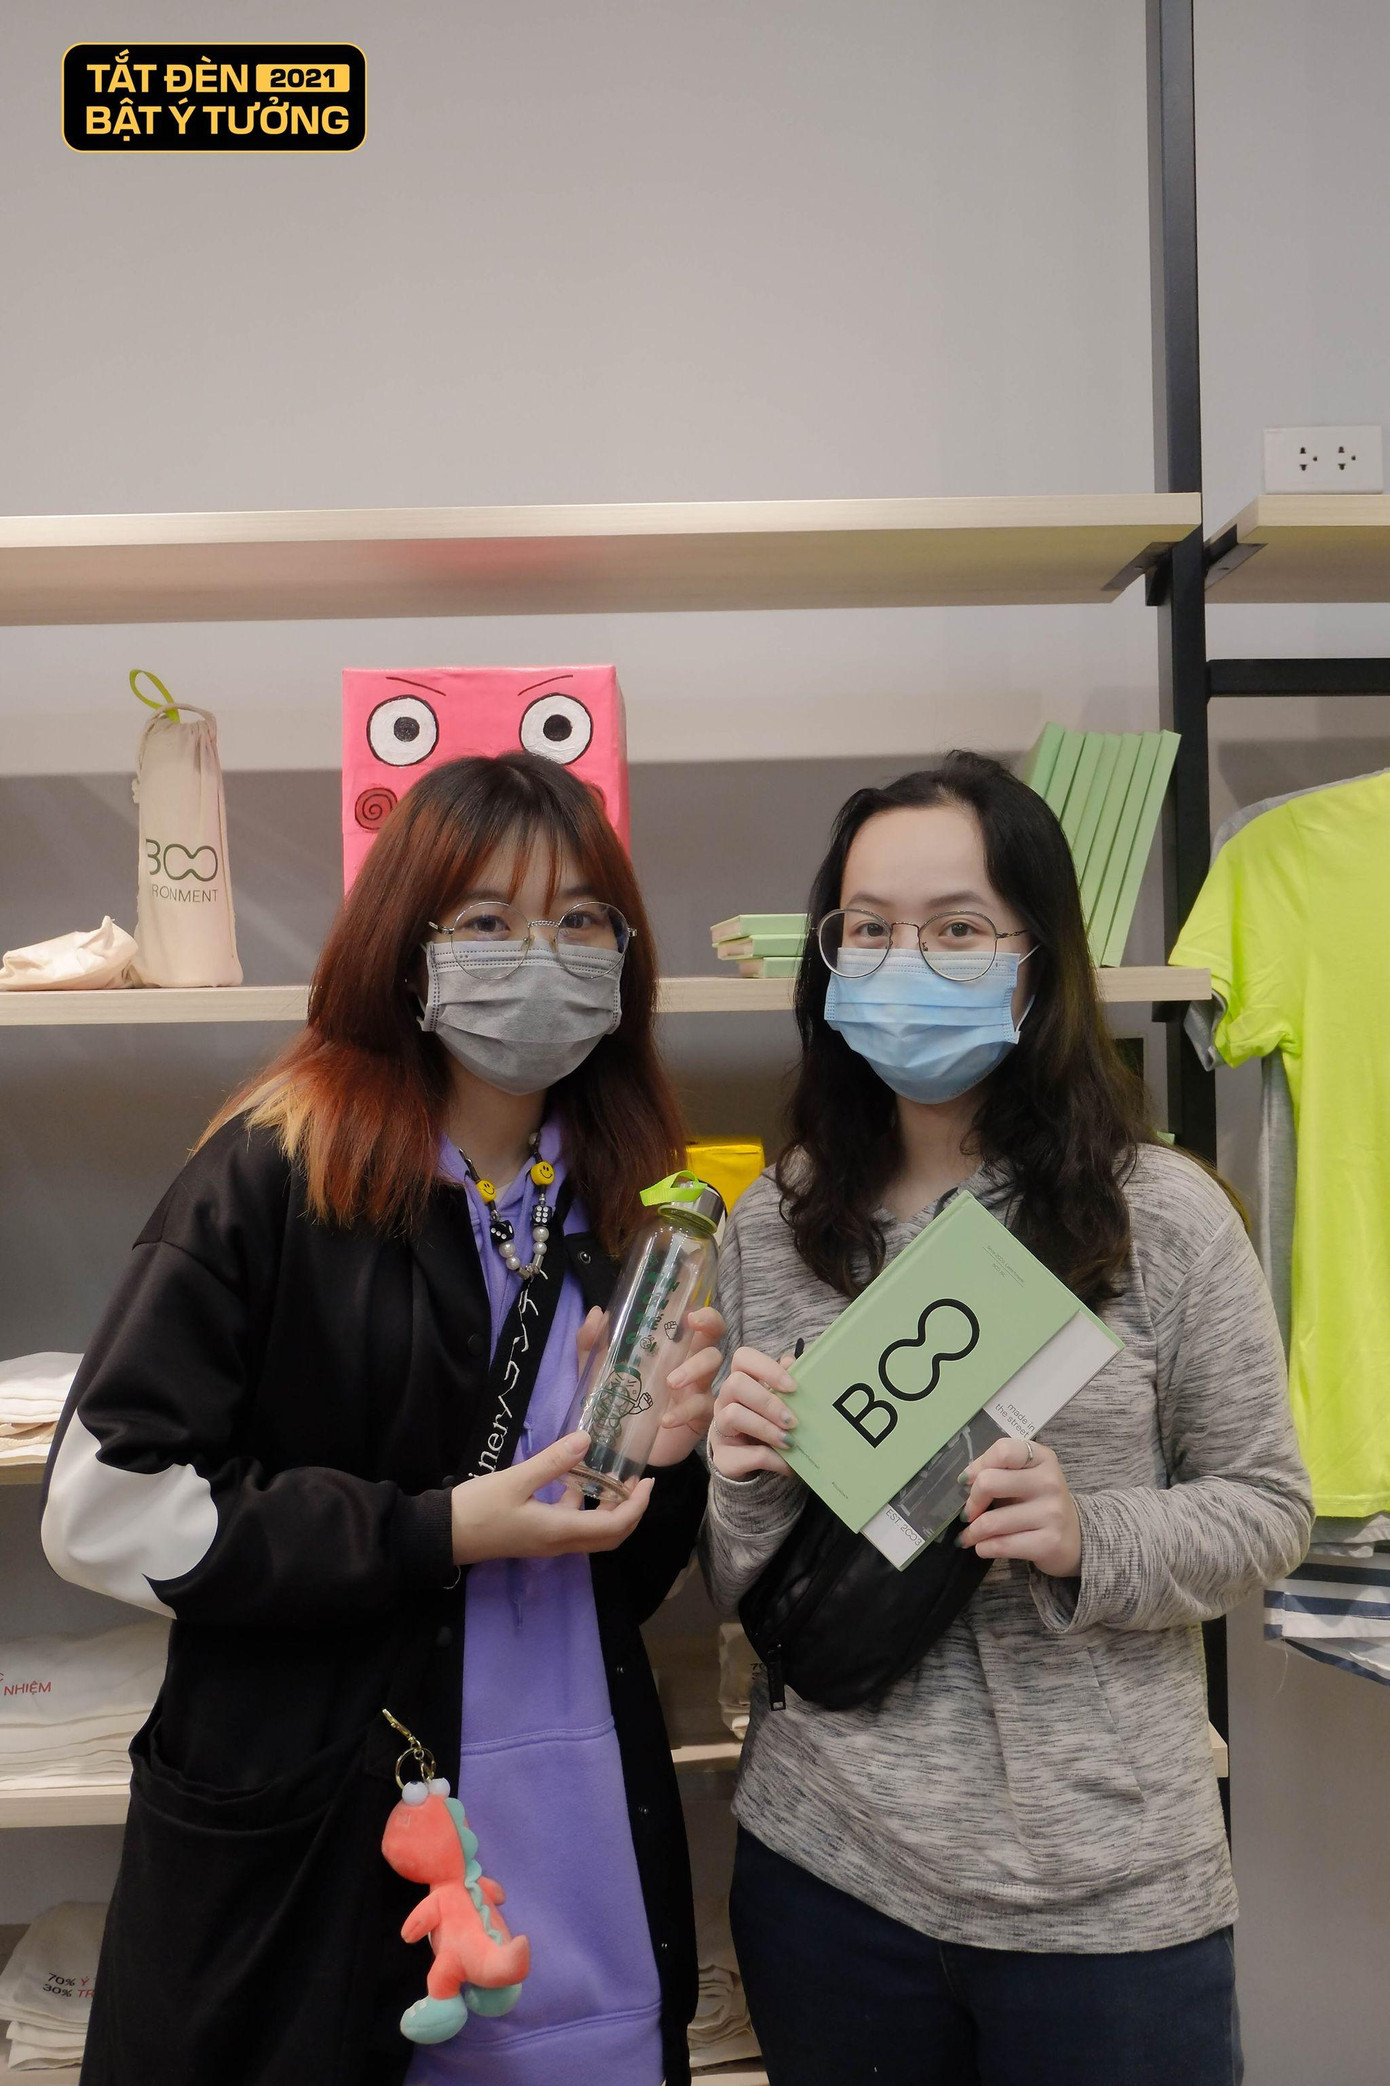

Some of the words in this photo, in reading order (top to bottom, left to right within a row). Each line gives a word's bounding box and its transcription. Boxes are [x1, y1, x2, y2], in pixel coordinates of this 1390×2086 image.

[831, 1297, 981, 1449] BOO
[995, 1403, 1009, 1418] the
[1007, 1416, 1029, 1438] street
[1007, 1403, 1029, 1425] made
[1026, 1422, 1036, 1432] in
[43, 1984, 73, 1997] 30%
[48, 1973, 76, 1987] 70%
